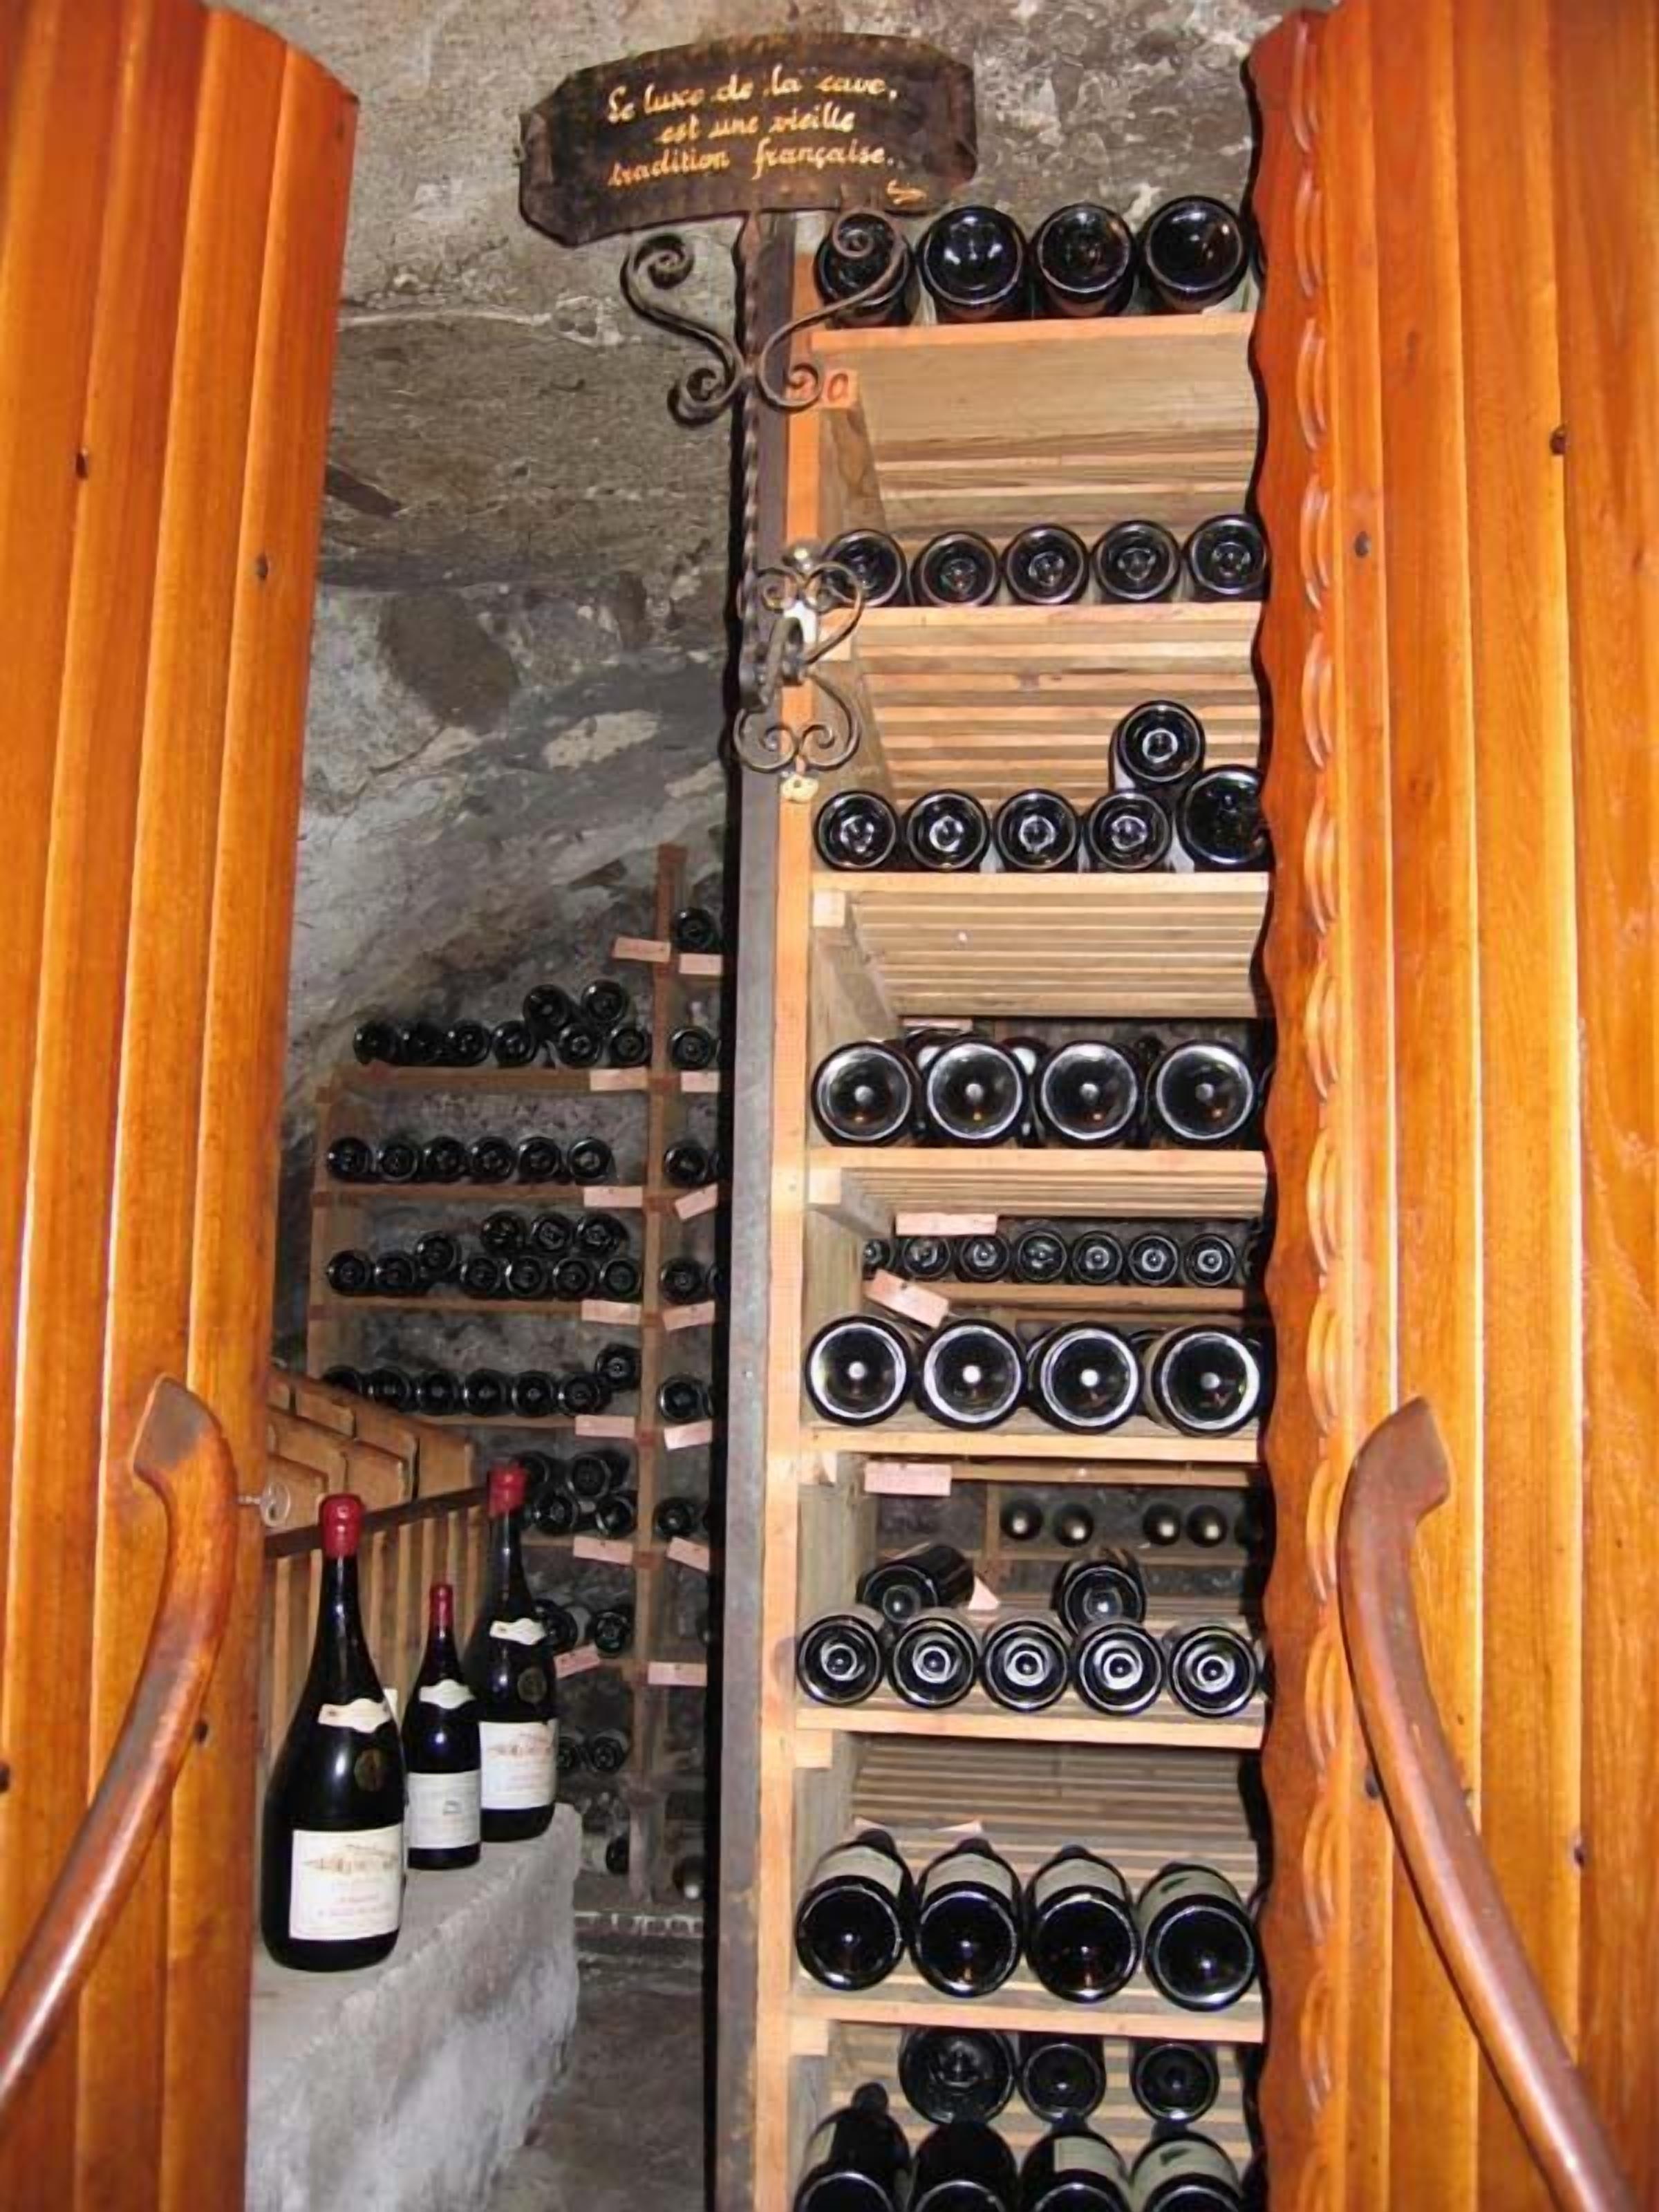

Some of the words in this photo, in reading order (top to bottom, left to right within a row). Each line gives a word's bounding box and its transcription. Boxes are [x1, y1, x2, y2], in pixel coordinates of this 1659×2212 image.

[608, 84, 636, 124] Le
[644, 82, 706, 115] luxe
[710, 73, 754, 102] de
[763, 63, 803, 97] la
[815, 75, 898, 102] cave,
[655, 113, 700, 144] est
[707, 115, 759, 139] une
[768, 101, 856, 133] vieille
[608, 147, 731, 187] tradition
[751, 137, 894, 181] française.
